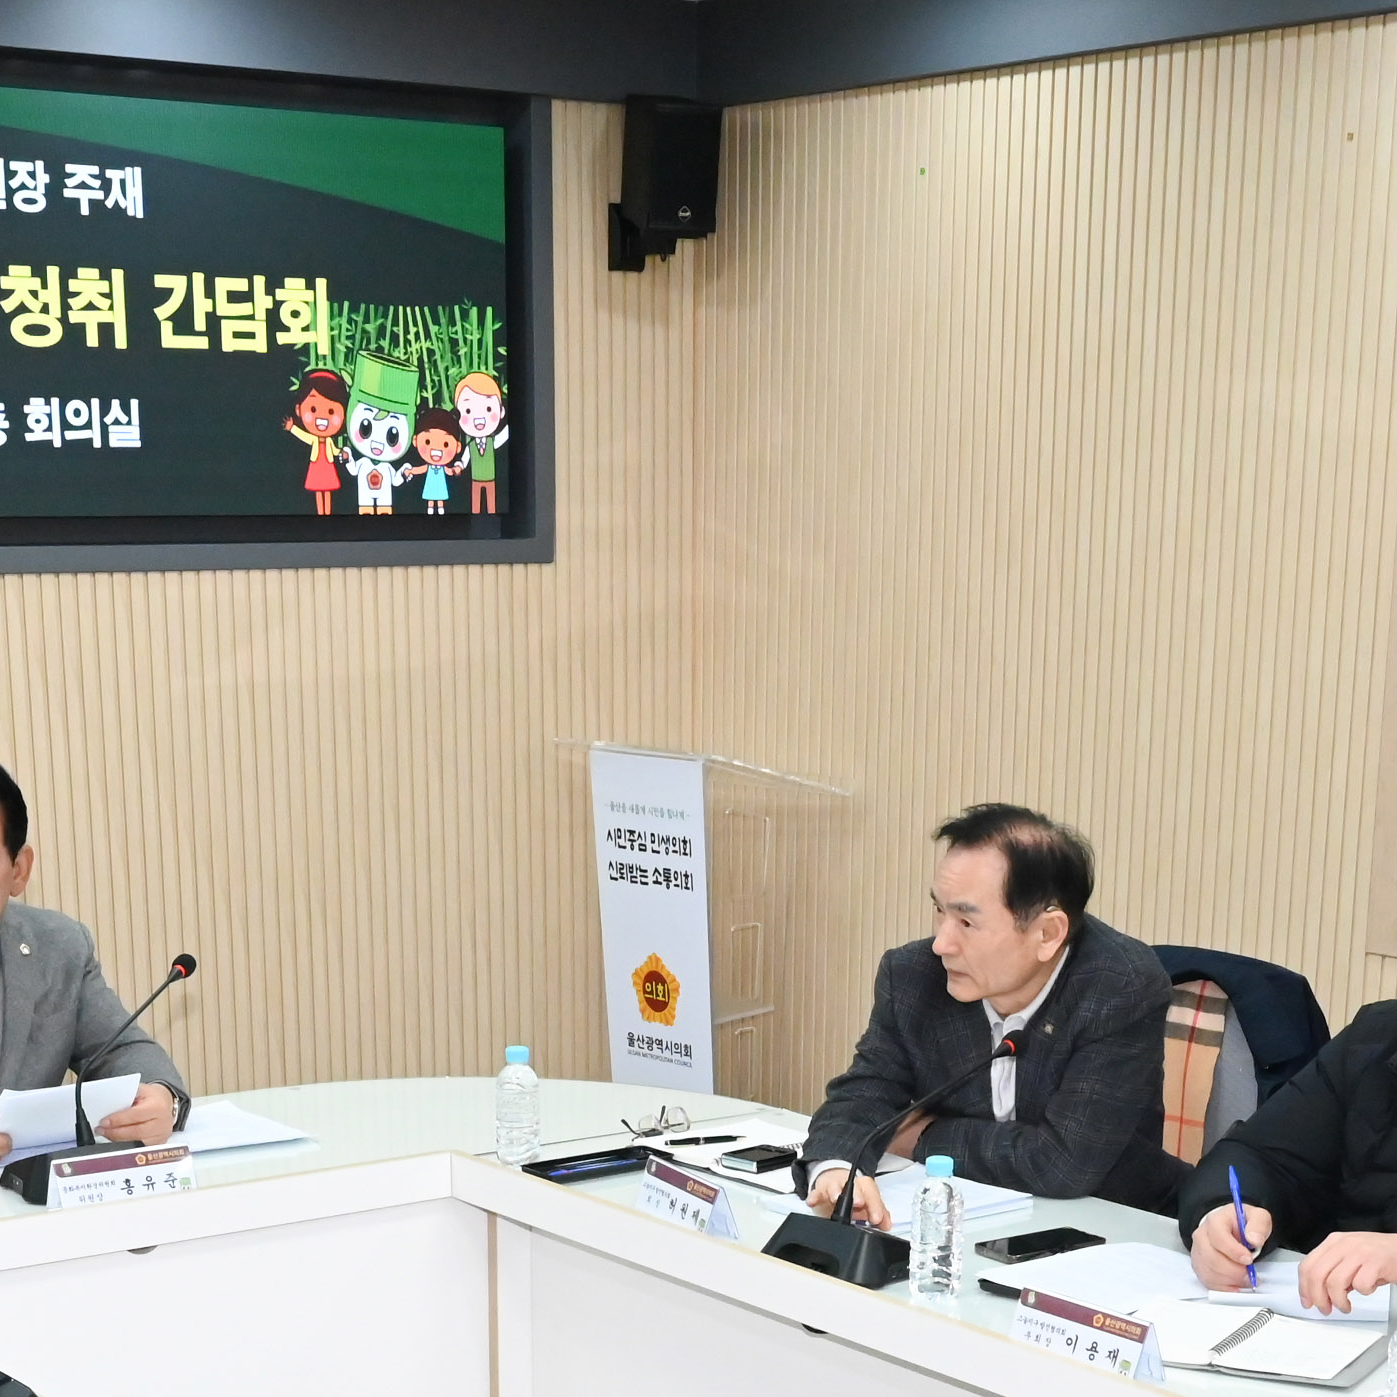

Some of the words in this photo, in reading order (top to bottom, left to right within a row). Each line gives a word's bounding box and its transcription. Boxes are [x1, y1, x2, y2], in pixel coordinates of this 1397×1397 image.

[62, 163, 145, 219] 주재
[0, 264, 128, 350] 청취
[153, 271, 332, 356] 간담회
[23, 396, 142, 449] 회의실
[606, 828, 648, 853] 시민중심
[650, 832, 692, 858] 민생의회
[608, 860, 649, 886] 신뢰받는
[652, 866, 694, 892] 소통의회
[644, 981, 669, 1002] 의회
[626, 1031, 693, 1060] 울산광역시의회
